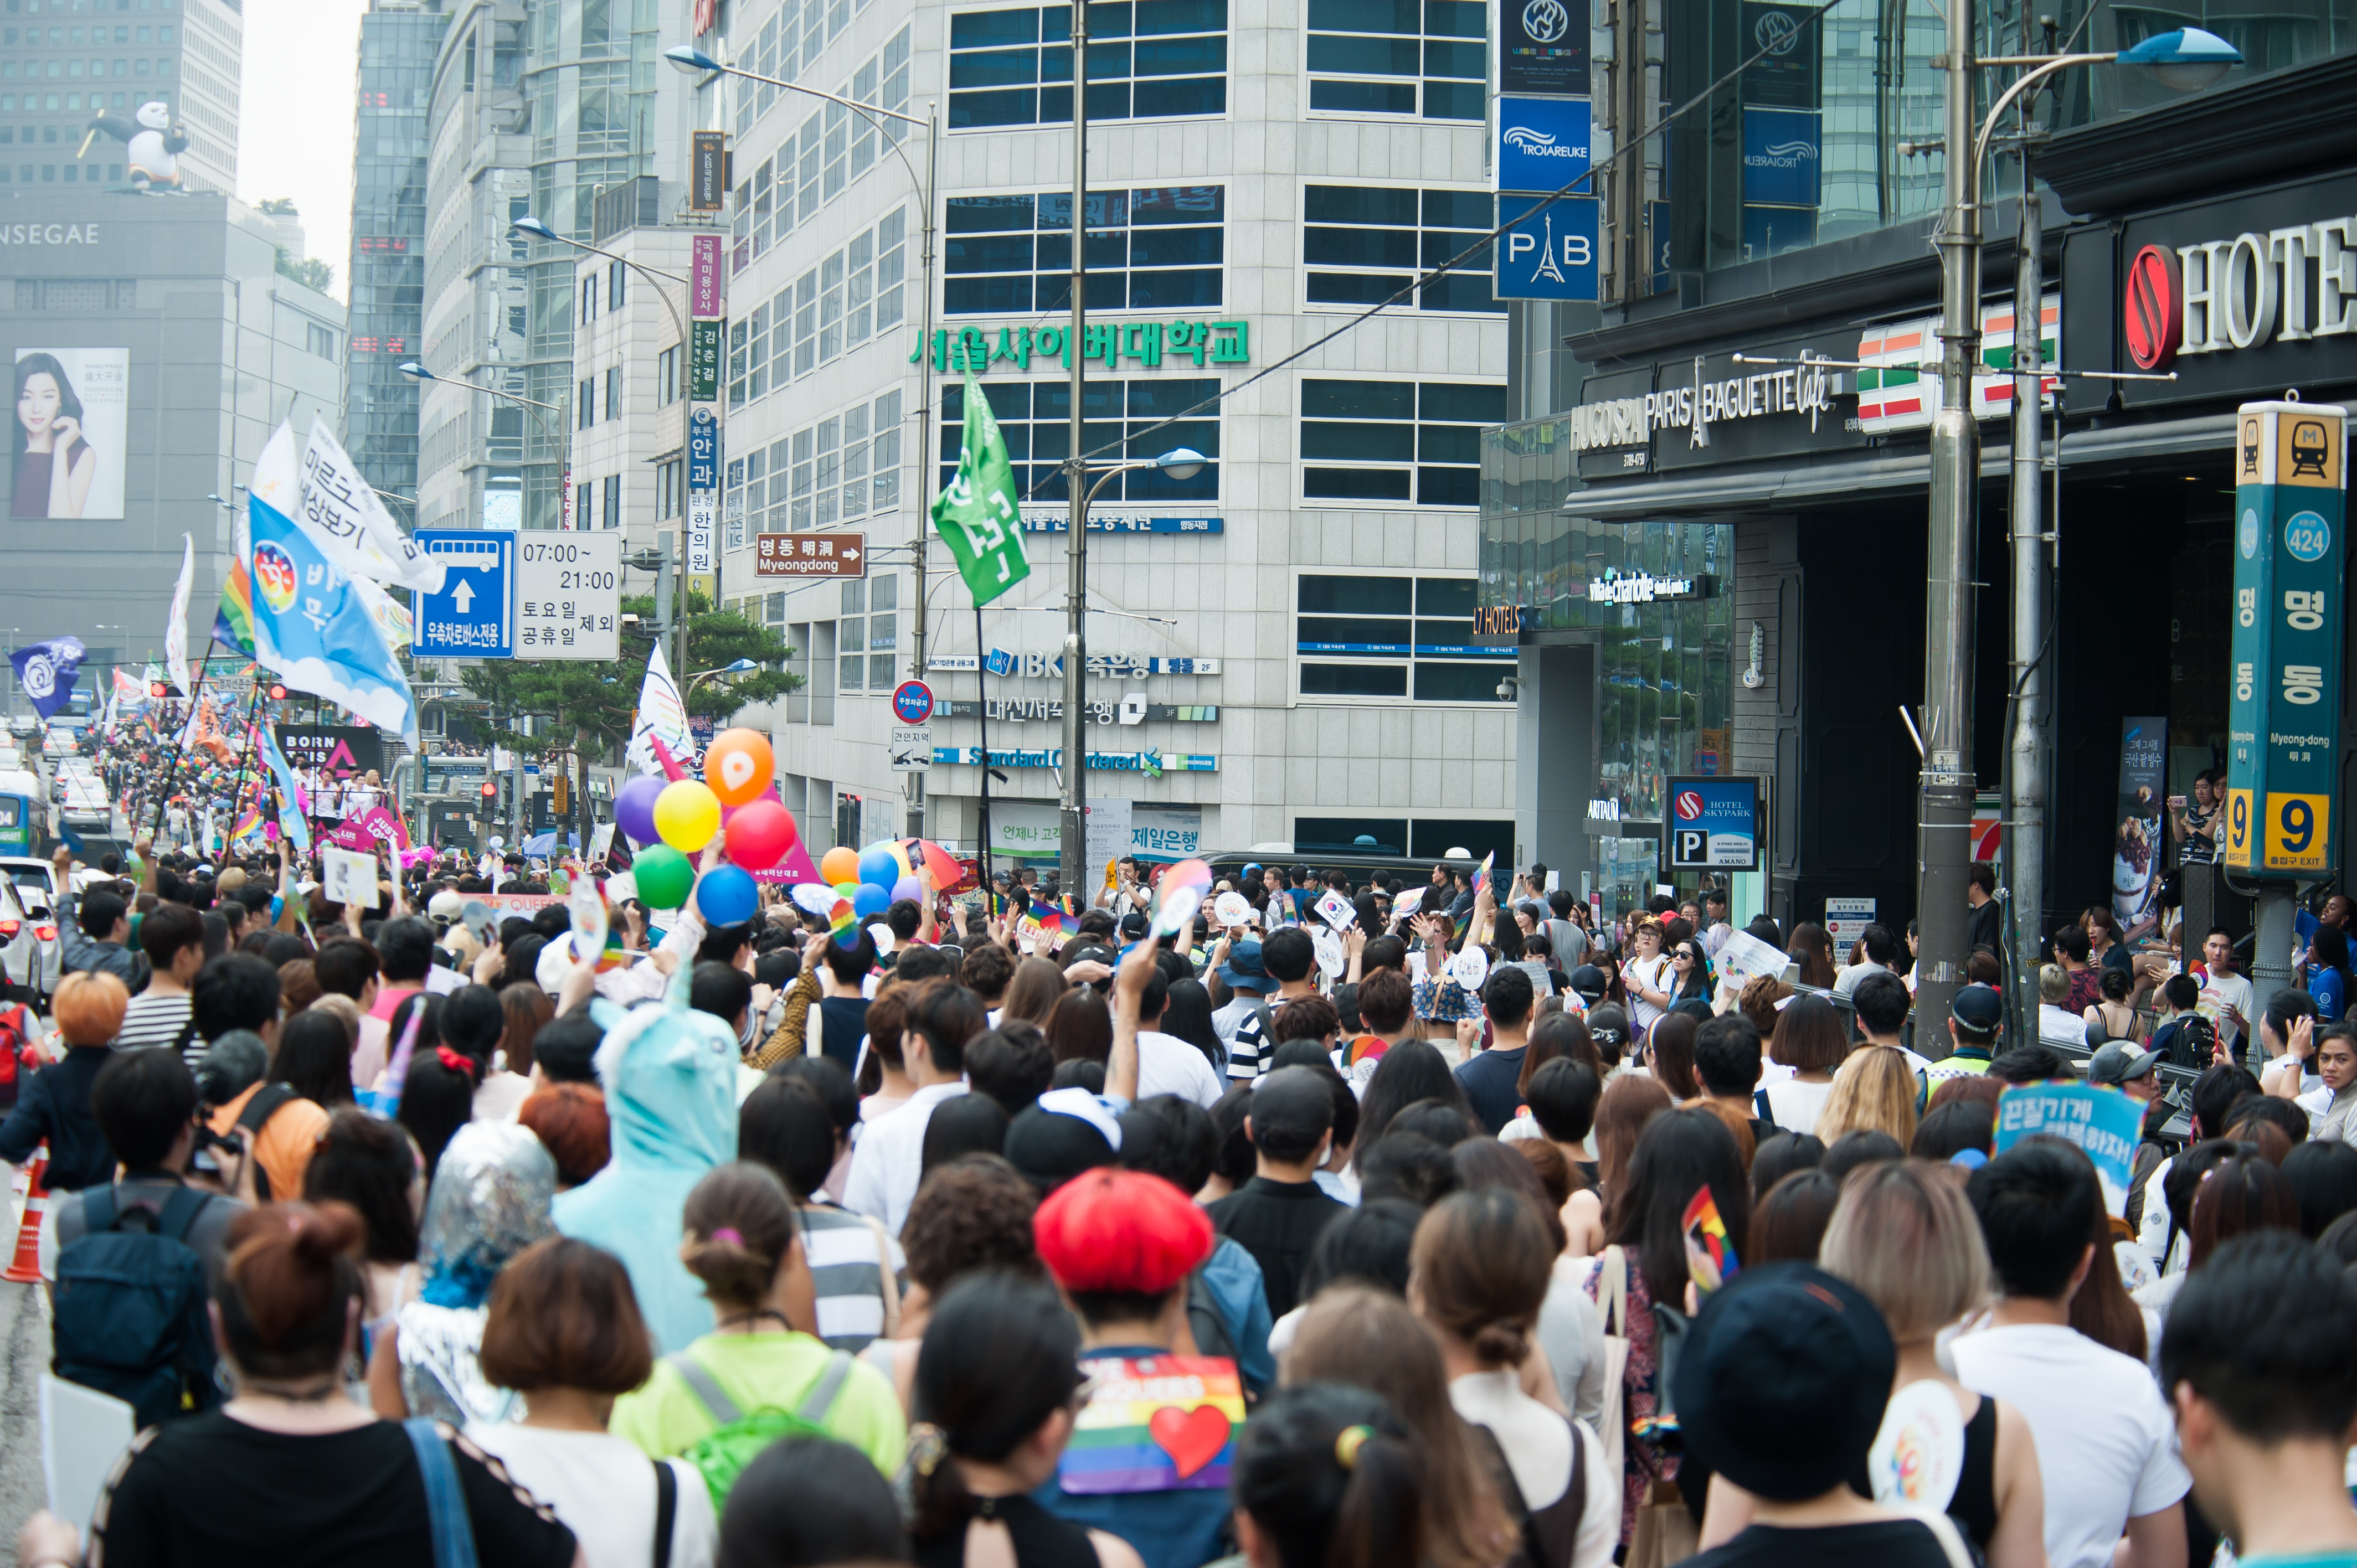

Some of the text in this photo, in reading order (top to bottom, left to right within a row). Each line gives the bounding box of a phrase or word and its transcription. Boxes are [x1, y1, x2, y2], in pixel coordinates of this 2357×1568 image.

[1522, 145, 1587, 158] TROIAREUKE
[700, 240, 713, 312] 국제미용상사
[2177, 216, 2357, 355] HOTE
[909, 320, 1250, 371] 서울사이버대학교
[703, 331, 716, 381] 김춘길
[1645, 386, 1691, 431] PARIS
[1704, 369, 1796, 423] BAGUETTE
[692, 426, 712, 436] 푸른
[1571, 397, 1649, 450] HUGO SPA
[692, 438, 713, 486] 안과
[1623, 452, 1645, 467] 3789-4750
[1020, 510, 1152, 530] 서울신보증재단
[1180, 520, 1208, 530] 명동지점
[692, 512, 711, 571] 한의원
[760, 539, 833, 556] 명동 明洞
[2290, 530, 2324, 552] 424
[760, 559, 838, 572] Myeongdong
[560, 571, 614, 589] 21:00
[1589, 577, 1605, 602] villa
[1605, 581, 1613, 601] de
[1612, 571, 1654, 603] charlotte
[522, 601, 575, 619] 토요일
[1474, 605, 1520, 635] L7 HOTELS
[579, 615, 613, 632] 제외
[427, 622, 498, 648] 우측차로버스전용
[522, 627, 575, 645] 공휴일
[2282, 591, 2325, 705] 명동
[1085, 650, 1150, 680] 축은행
[1168, 658, 1194, 674] 명동
[219, 679, 251, 689] 정지선준수
[899, 697, 928, 708] 주정차금지
[286, 736, 335, 748] BORN
[894, 733, 929, 742] 견인지역
[2271, 733, 2329, 749] Myeong-dong
[286, 750, 327, 763] TIS
[969, 746, 1141, 771] Sandard Crtered
[2124, 752, 2162, 768] 국산 팥 빙수
[2289, 751, 2310, 762] 明洞
[1587, 799, 1619, 822] ARITAUM
[373, 816, 399, 839] JUST
[2233, 795, 2246, 848] 9
[2281, 799, 2314, 853] 9
[1003, 826, 1038, 841] 언제나
[1132, 827, 1198, 852] 제일은행
[1683, 832, 1700, 860] P
[2271, 857, 2320, 865] 출입구 EXIT
